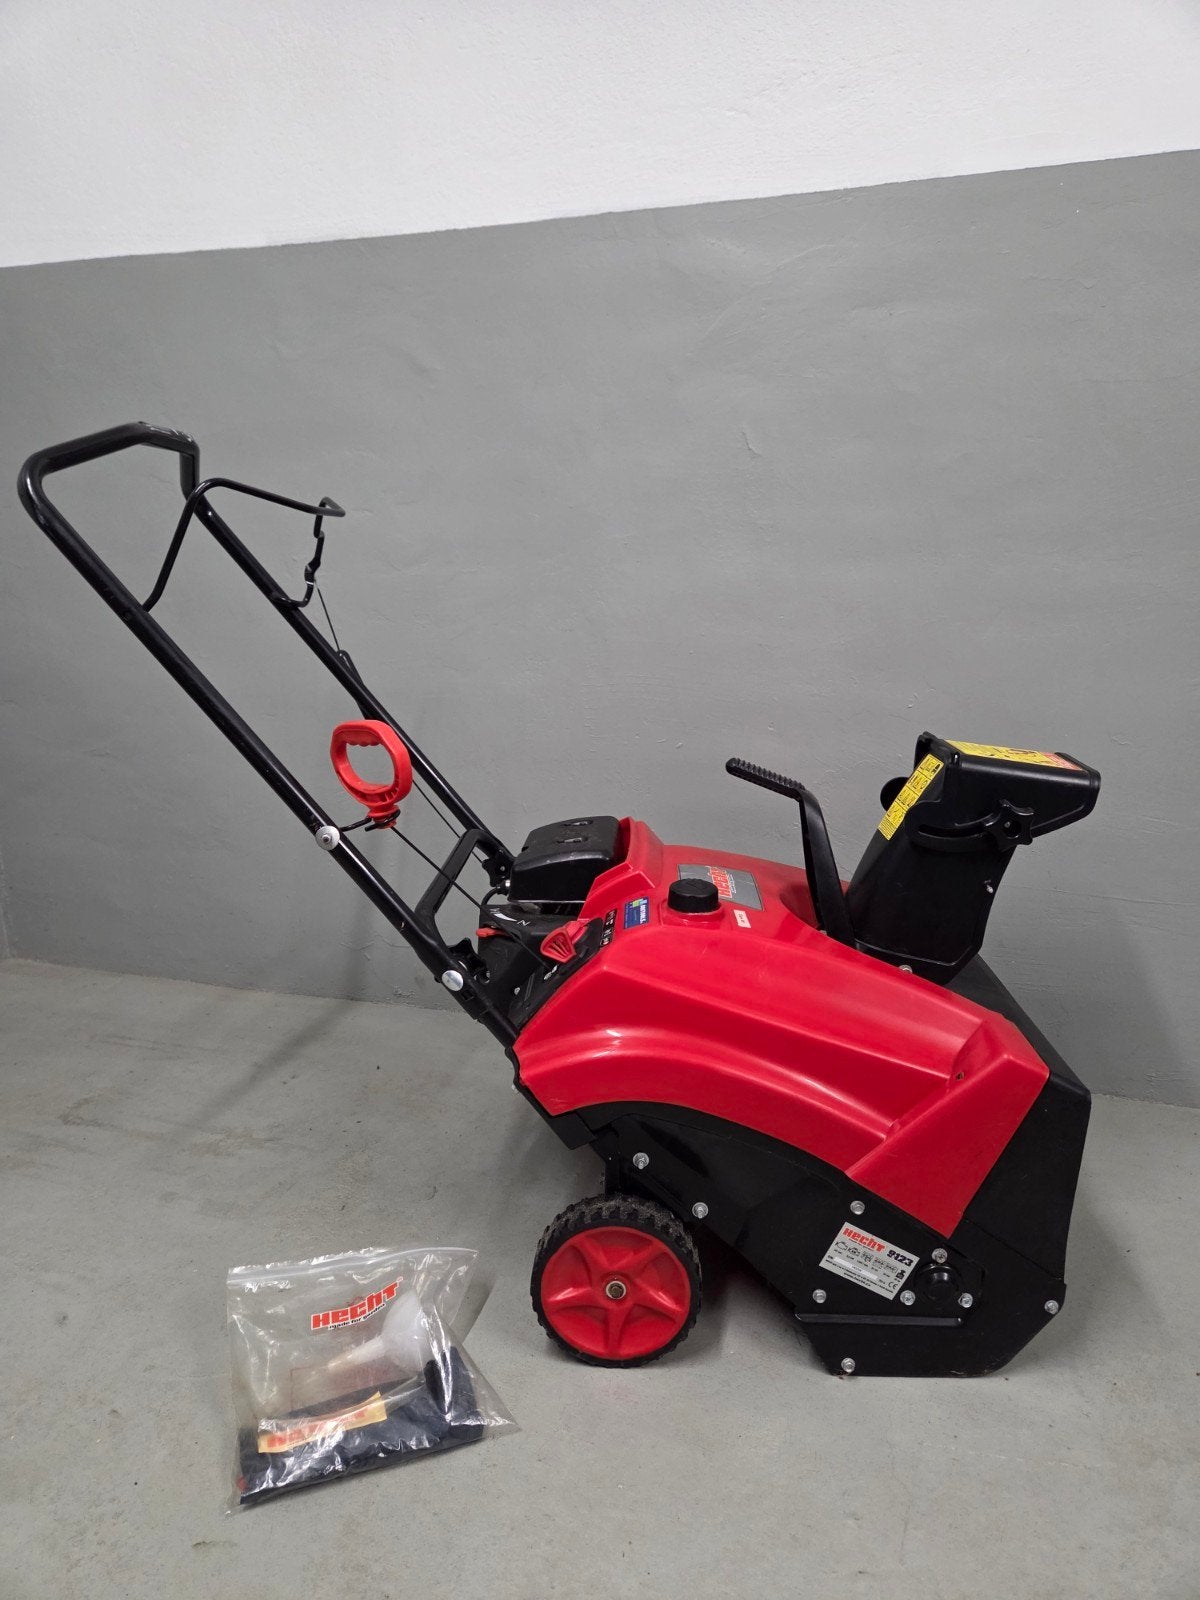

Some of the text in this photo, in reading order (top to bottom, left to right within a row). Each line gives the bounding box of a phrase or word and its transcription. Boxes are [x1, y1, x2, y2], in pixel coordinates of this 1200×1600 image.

[887, 1249, 914, 1267] 9123
[311, 1281, 399, 1330] HECHT
[363, 1303, 386, 1320] garden
